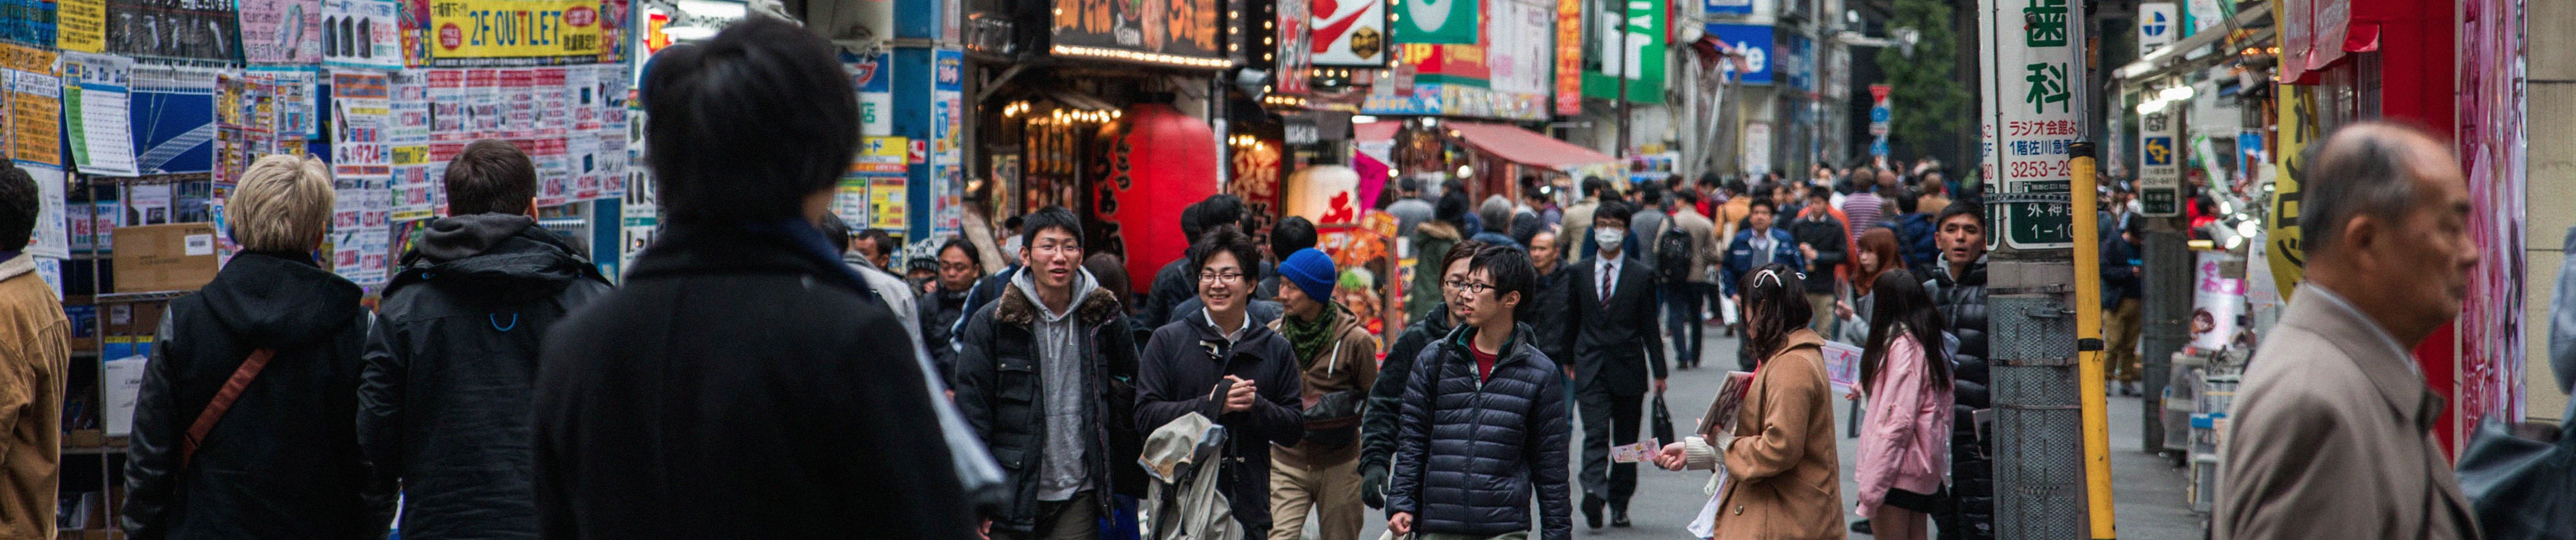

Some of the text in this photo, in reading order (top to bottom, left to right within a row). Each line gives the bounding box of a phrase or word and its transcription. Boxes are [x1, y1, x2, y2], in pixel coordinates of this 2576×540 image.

[469, 10, 490, 46] 2F
[494, 10, 561, 46] OUTLET
[2023, 0, 2071, 114] 歯科
